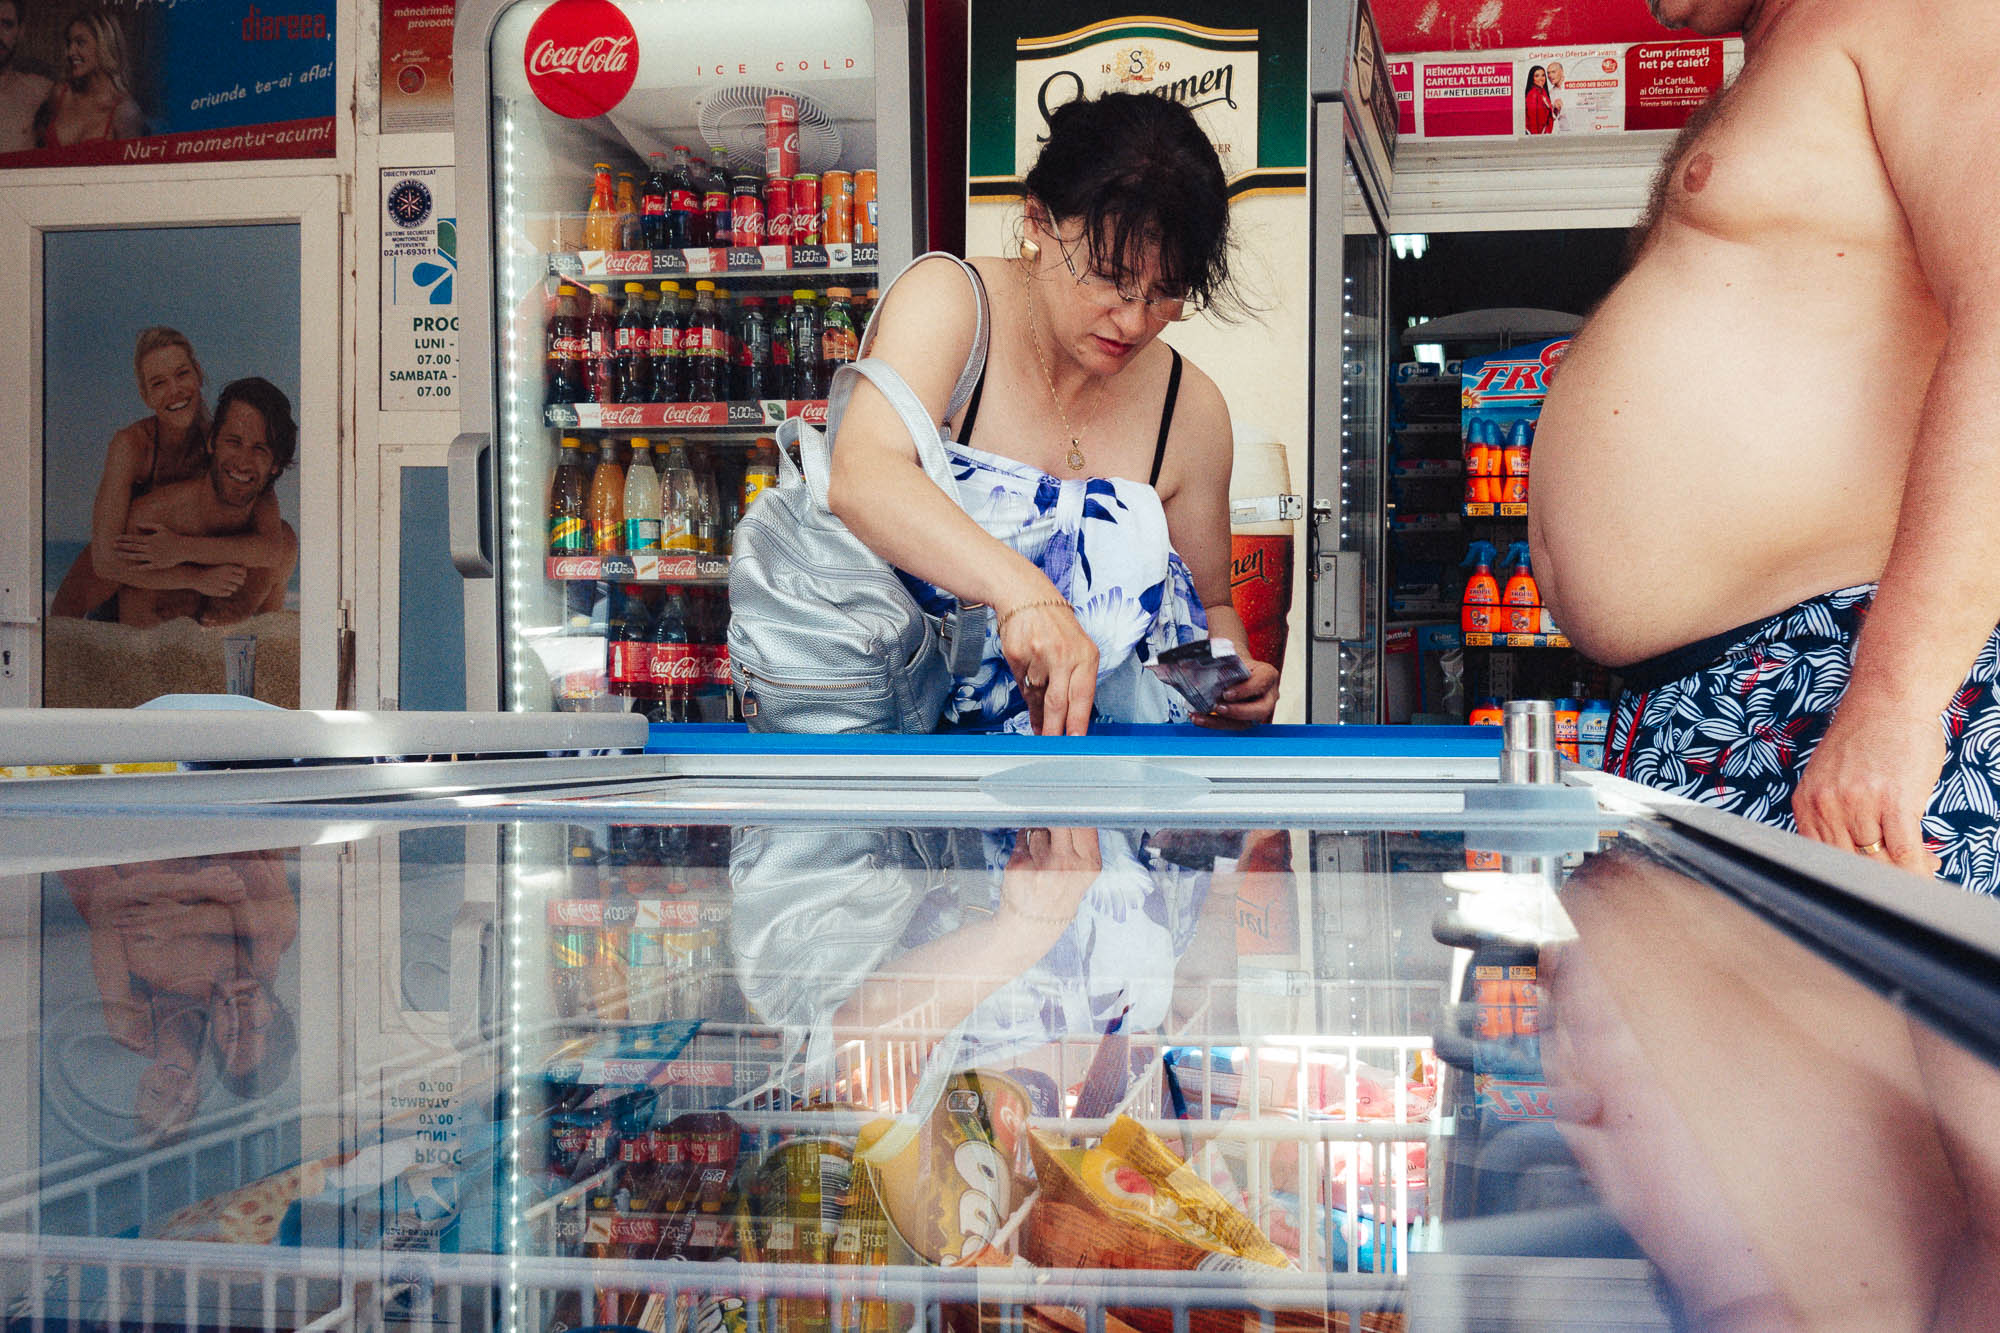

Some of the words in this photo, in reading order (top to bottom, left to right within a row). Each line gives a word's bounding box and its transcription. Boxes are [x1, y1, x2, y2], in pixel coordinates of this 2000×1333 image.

[242, 3, 331, 41] diareea,
[530, 36, 634, 77] Coca-Cola
[1639, 48, 1663, 58] Cum
[697, 64, 747, 77] ICE
[775, 58, 855, 72] COLD
[1101, 64, 1111, 74] 18
[1158, 61, 1171, 72] 69
[1477, 65, 1495, 75] AICI
[1639, 60, 1657, 69] net
[1660, 60, 1674, 71] pe
[191, 83, 246, 111] oriunde
[255, 72, 293, 94] te-ai
[300, 61, 334, 83] afla!
[1425, 77, 1466, 86] CARTELA
[1466, 75, 1511, 85] TELEKOM!
[1653, 77, 1663, 86] La
[1427, 89, 1441, 97] HAI
[1443, 87, 1510, 97] #NETLIBERARE!
[1648, 86, 1674, 95] Oferta
[123, 140, 166, 161] Nu-i
[175, 120, 332, 155] momentu-acum!
[384, 248, 436, 256] 0241-693011
[794, 250, 815, 264] 3,00
[853, 248, 875, 261] 3,00
[605, 254, 650, 272] Coca-Cola
[653, 255, 674, 268] 3,50
[729, 252, 750, 266] 3,00
[415, 338, 445, 349] LUNI
[417, 354, 451, 365] 07.00
[390, 370, 448, 381] SAMBATA
[417, 386, 451, 397] 07.00
[663, 405, 712, 424] Coca-Cola
[729, 406, 751, 419] 5,00
[556, 559, 600, 577] Coca-Cola
[602, 561, 623, 574] 4,00
[697, 561, 719, 574] 4,00
[651, 656, 699, 678] Coca-Cola
